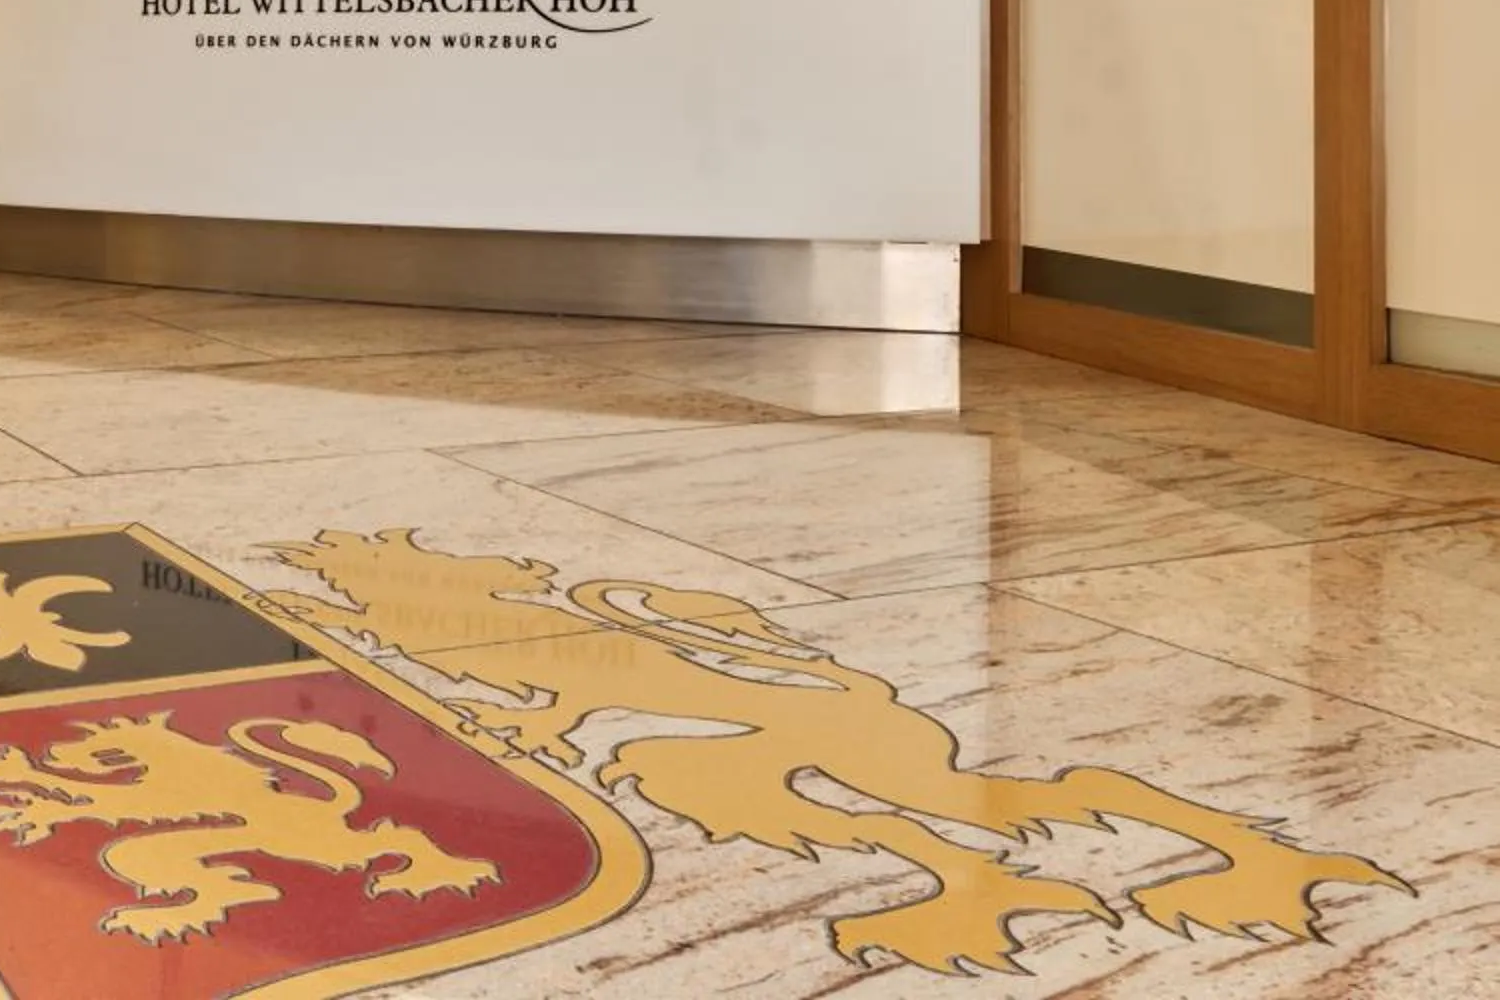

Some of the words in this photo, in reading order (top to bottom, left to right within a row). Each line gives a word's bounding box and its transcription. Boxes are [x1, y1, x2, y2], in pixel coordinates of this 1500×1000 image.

[195, 33, 237, 48] ÜBER
[246, 34, 281, 48] DEN
[290, 33, 380, 49] DÄCHERN
[390, 34, 432, 49] VON
[442, 33, 558, 49] WÜRZBURG
